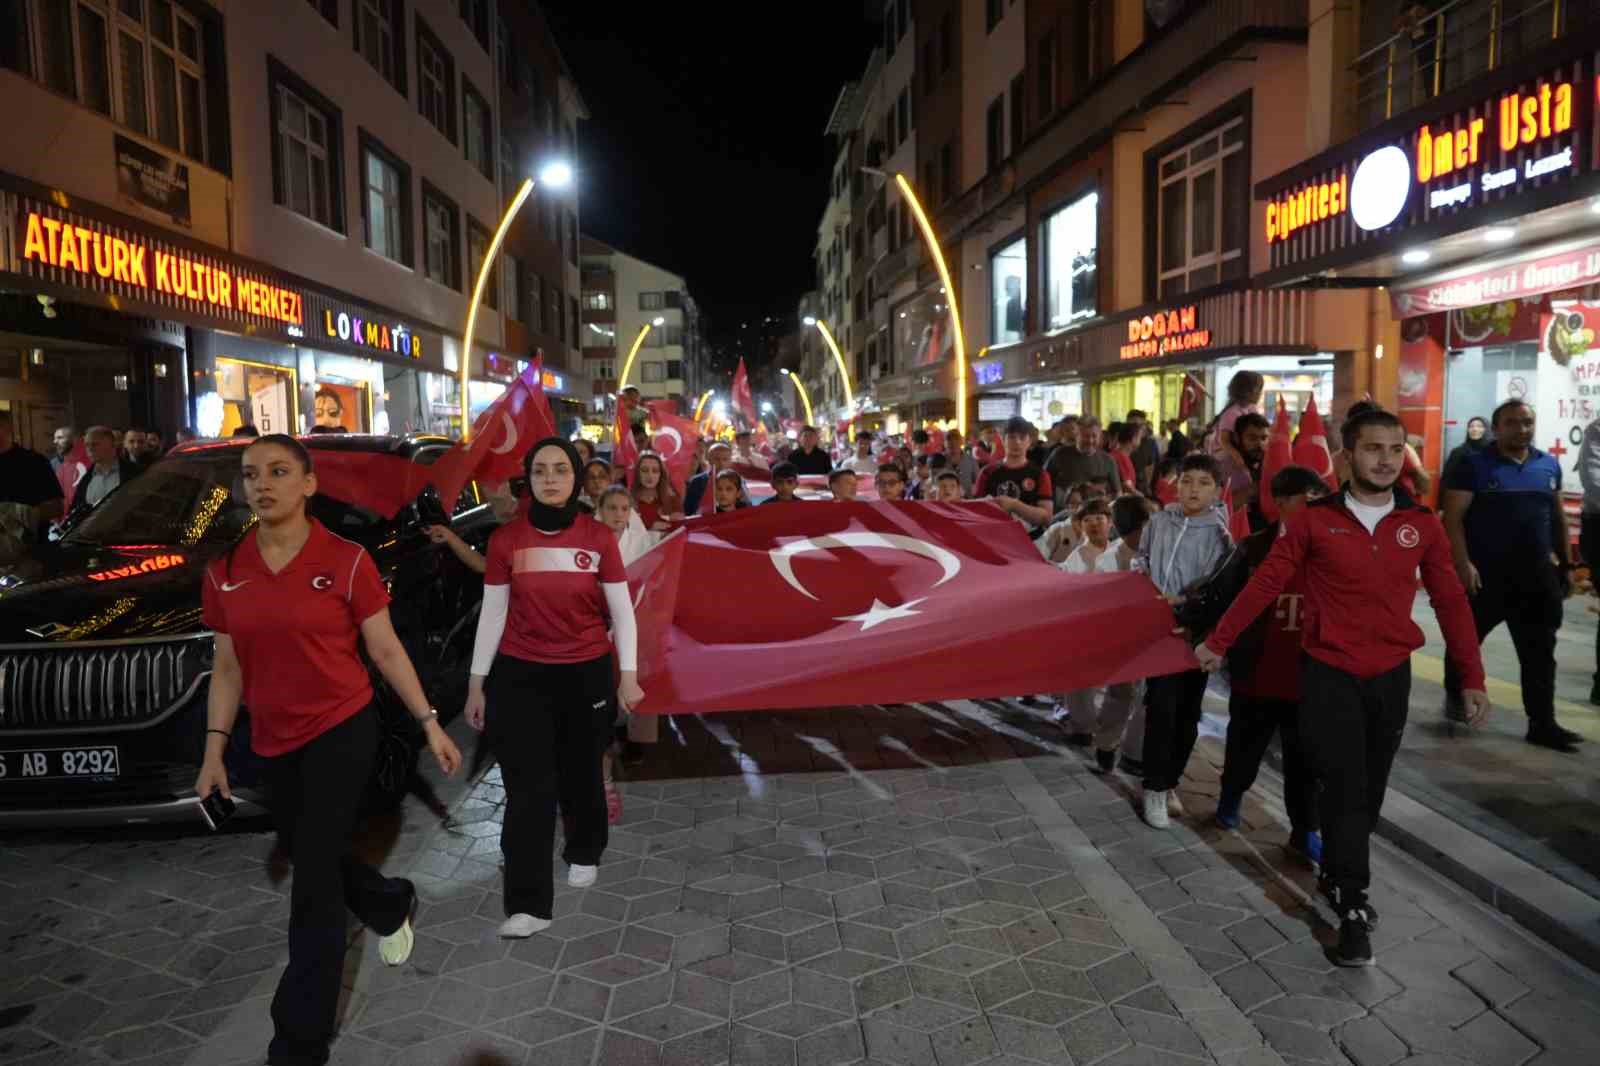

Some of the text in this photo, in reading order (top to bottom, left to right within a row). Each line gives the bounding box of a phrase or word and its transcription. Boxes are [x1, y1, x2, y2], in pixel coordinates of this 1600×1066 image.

[1417, 118, 1484, 183] Ömer
[1500, 83, 1573, 151] Usta
[1163, 329, 1210, 353] SALONU
[22, 752, 48, 777] AB
[62, 750, 117, 774] 8292
